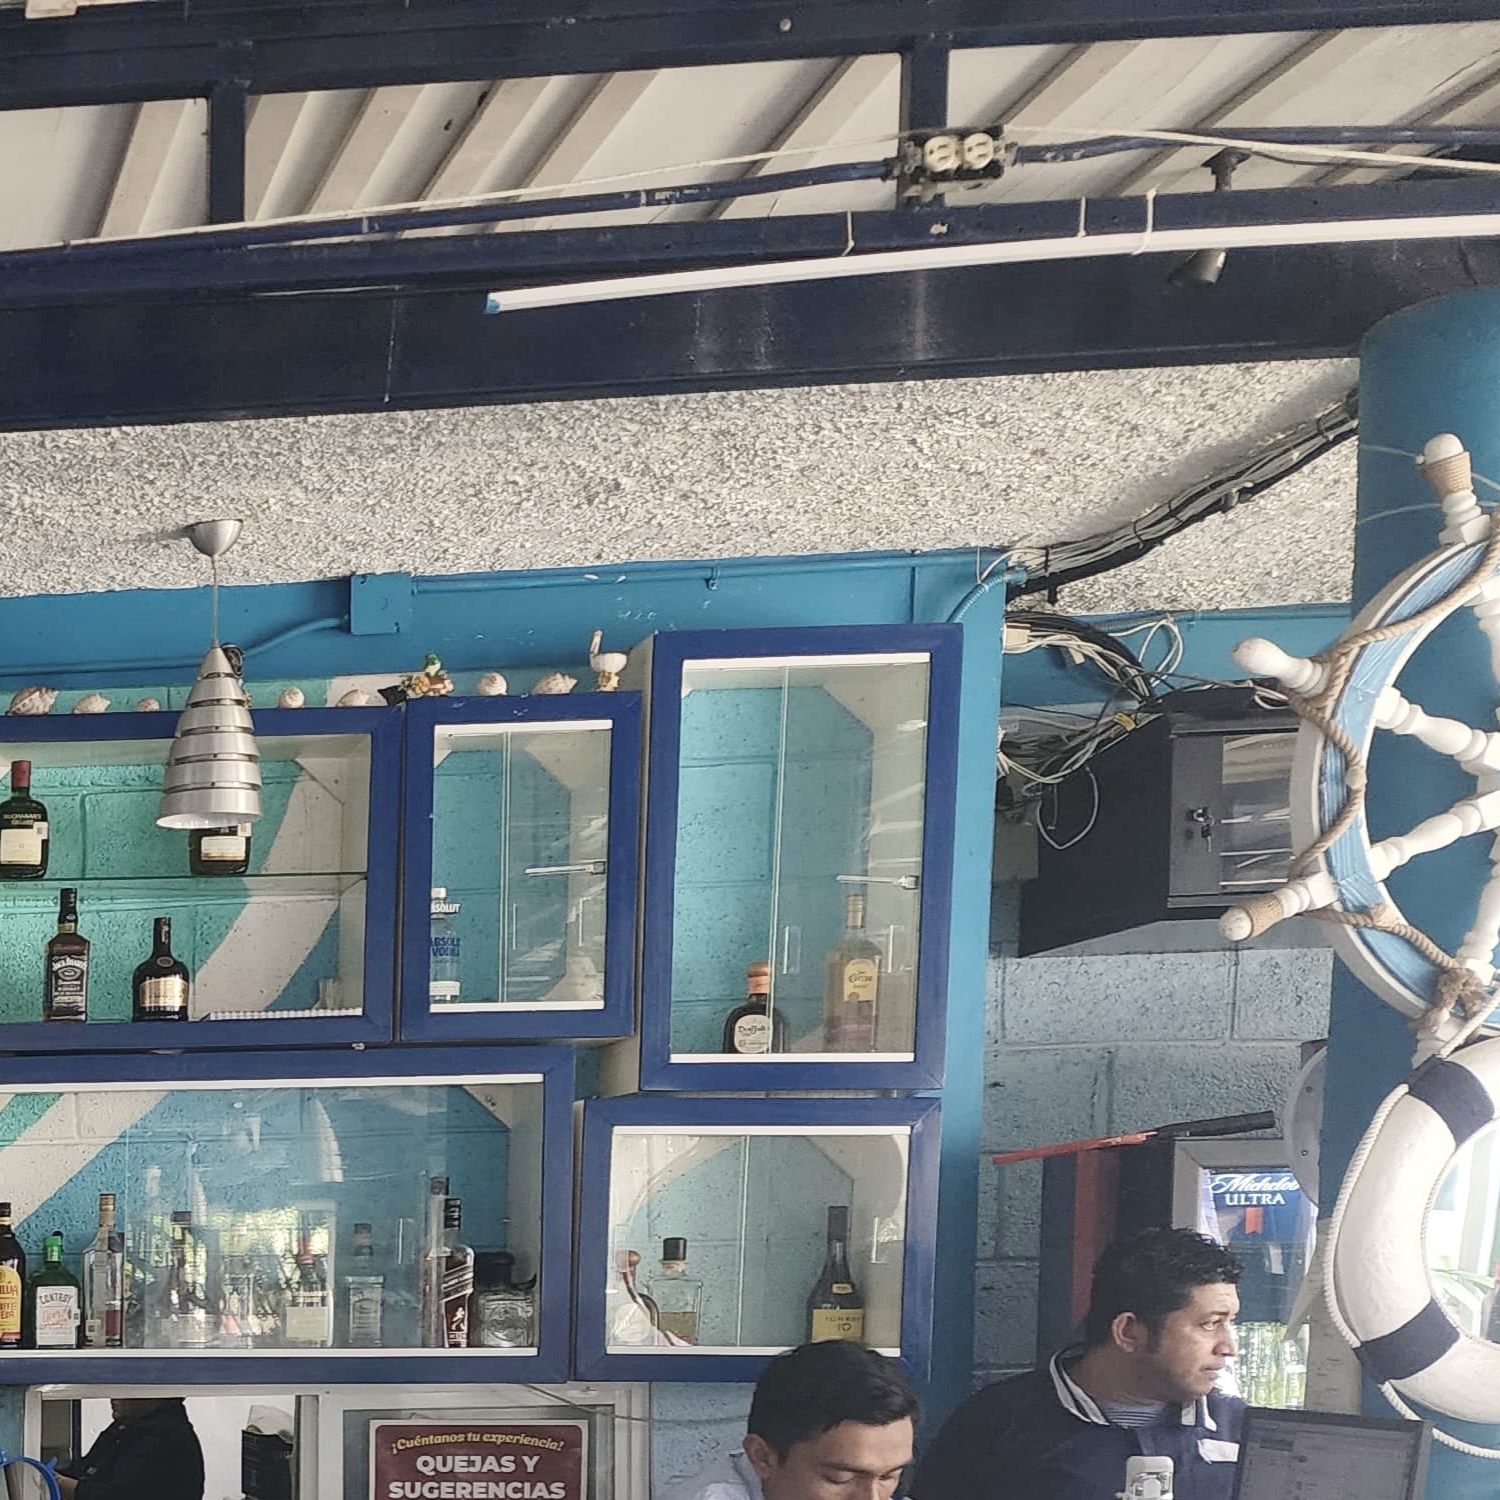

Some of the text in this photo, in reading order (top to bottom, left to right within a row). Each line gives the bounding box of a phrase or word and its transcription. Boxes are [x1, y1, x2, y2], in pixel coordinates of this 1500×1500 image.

[1224, 1193, 1286, 1206] ULTRA
[392, 1432, 565, 1454] ¡Cuéntanos tu experiencia!
[416, 1455, 541, 1476] QUEJAS Y
[388, 1481, 566, 1499] SUGERENCIAS
